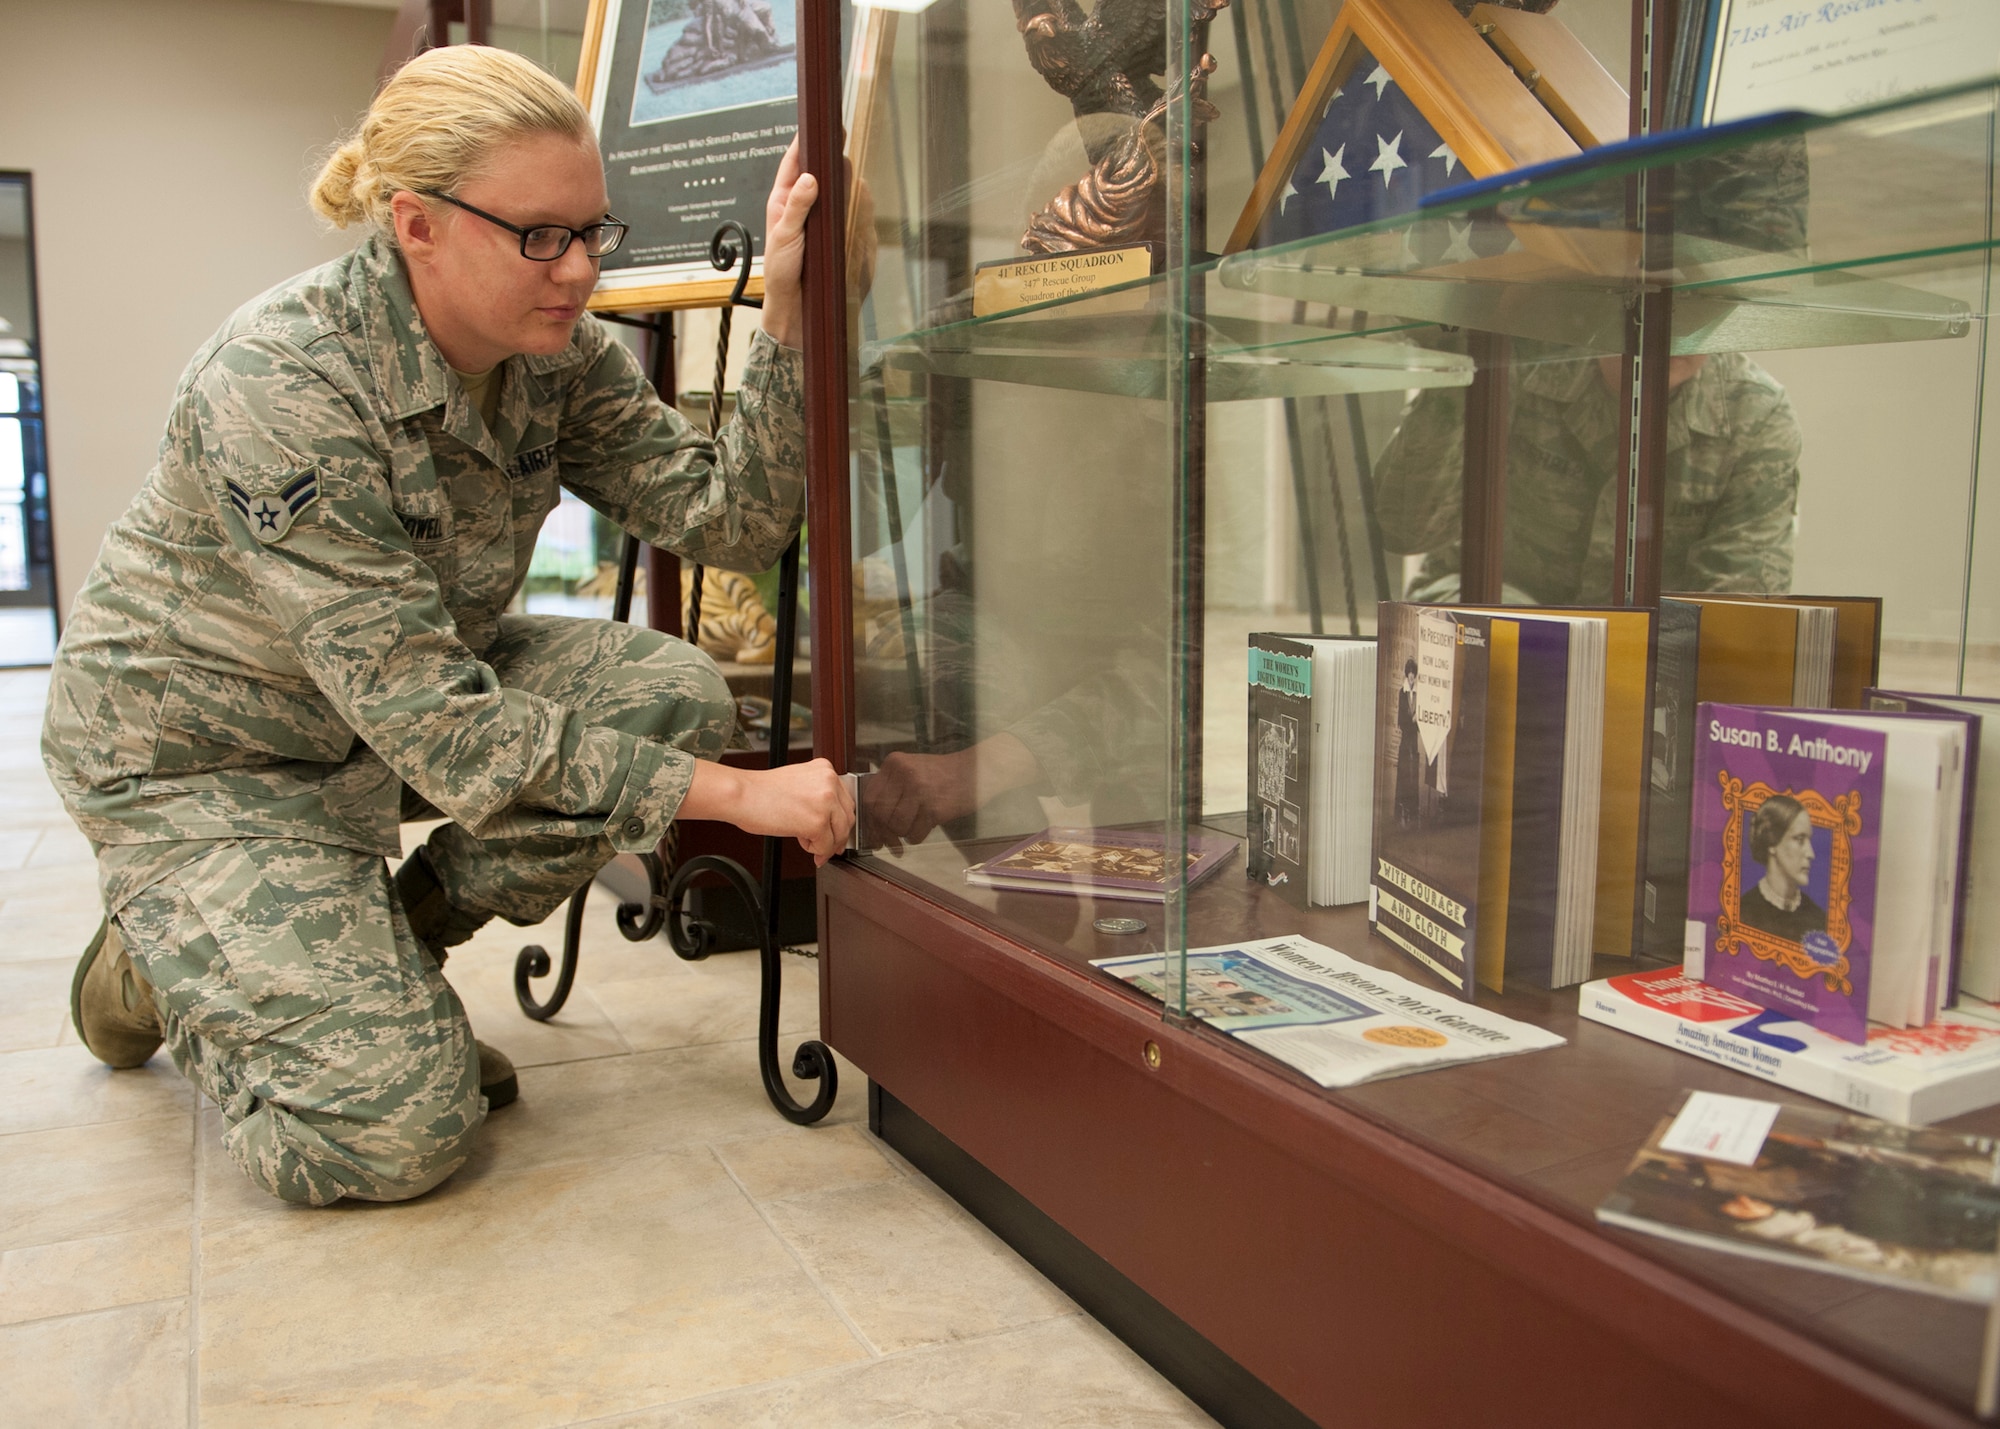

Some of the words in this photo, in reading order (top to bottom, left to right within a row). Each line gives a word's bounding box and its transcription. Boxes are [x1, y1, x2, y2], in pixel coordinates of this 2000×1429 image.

[1729, 24, 1769, 48] 71st
[1775, 11, 1811, 35] Air
[732, 131, 758, 143] DURING
[1015, 262, 1058, 277] RESCUE
[1060, 252, 1125, 272] SQUADRON
[1042, 276, 1070, 288] Rescue
[1071, 273, 1096, 284] Group
[1020, 291, 1055, 304] Squadron
[1057, 288, 1067, 298] of
[1067, 287, 1079, 296] the
[1428, 628, 1455, 649] PRESIDENT
[1263, 657, 1274, 671] THE
[1275, 660, 1299, 677] WOMEN'S
[1423, 655, 1434, 667] HOW
[1435, 657, 1449, 671] LONG
[1277, 675, 1306, 694] MOVEMENT
[1709, 720, 1762, 749] Susan
[1766, 729, 1783, 753] B.
[1788, 734, 1873, 774] Anthony
[1384, 863, 1407, 889] WITH
[1411, 879, 1461, 921] COURAGE
[1391, 899, 1412, 923] AND
[1415, 914, 1448, 948] CLOTH
[1265, 944, 1335, 975] Women's
[1328, 971, 1394, 996] History
[1386, 995, 1442, 1015] 2013
[1595, 1001, 1616, 1014] Haven
[1677, 1022, 1710, 1046] Amazing
[1712, 1032, 1749, 1056] American
[1752, 1046, 1781, 1068] Women
